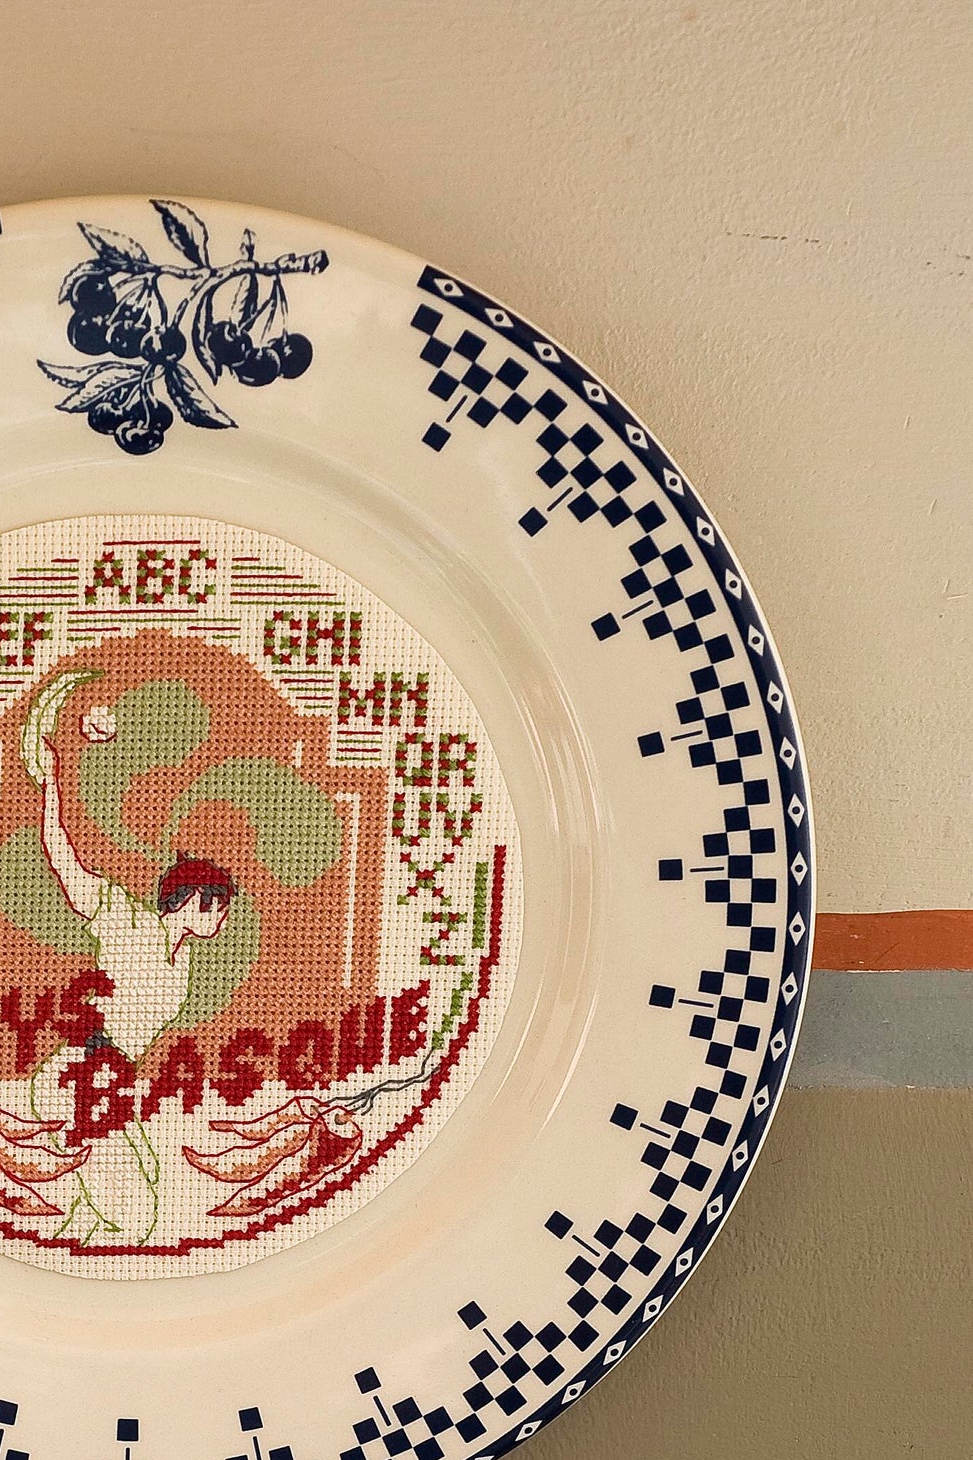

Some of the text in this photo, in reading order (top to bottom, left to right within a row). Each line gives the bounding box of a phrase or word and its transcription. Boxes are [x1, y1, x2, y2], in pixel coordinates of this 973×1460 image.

[84, 548, 217, 604] ABC
[263, 611, 362, 665] GHI
[337, 671, 429, 727] MN
[391, 793, 483, 847] UV
[397, 852, 455, 906] X
[420, 912, 468, 966] Z
[58, 979, 431, 1148] BASQUE
